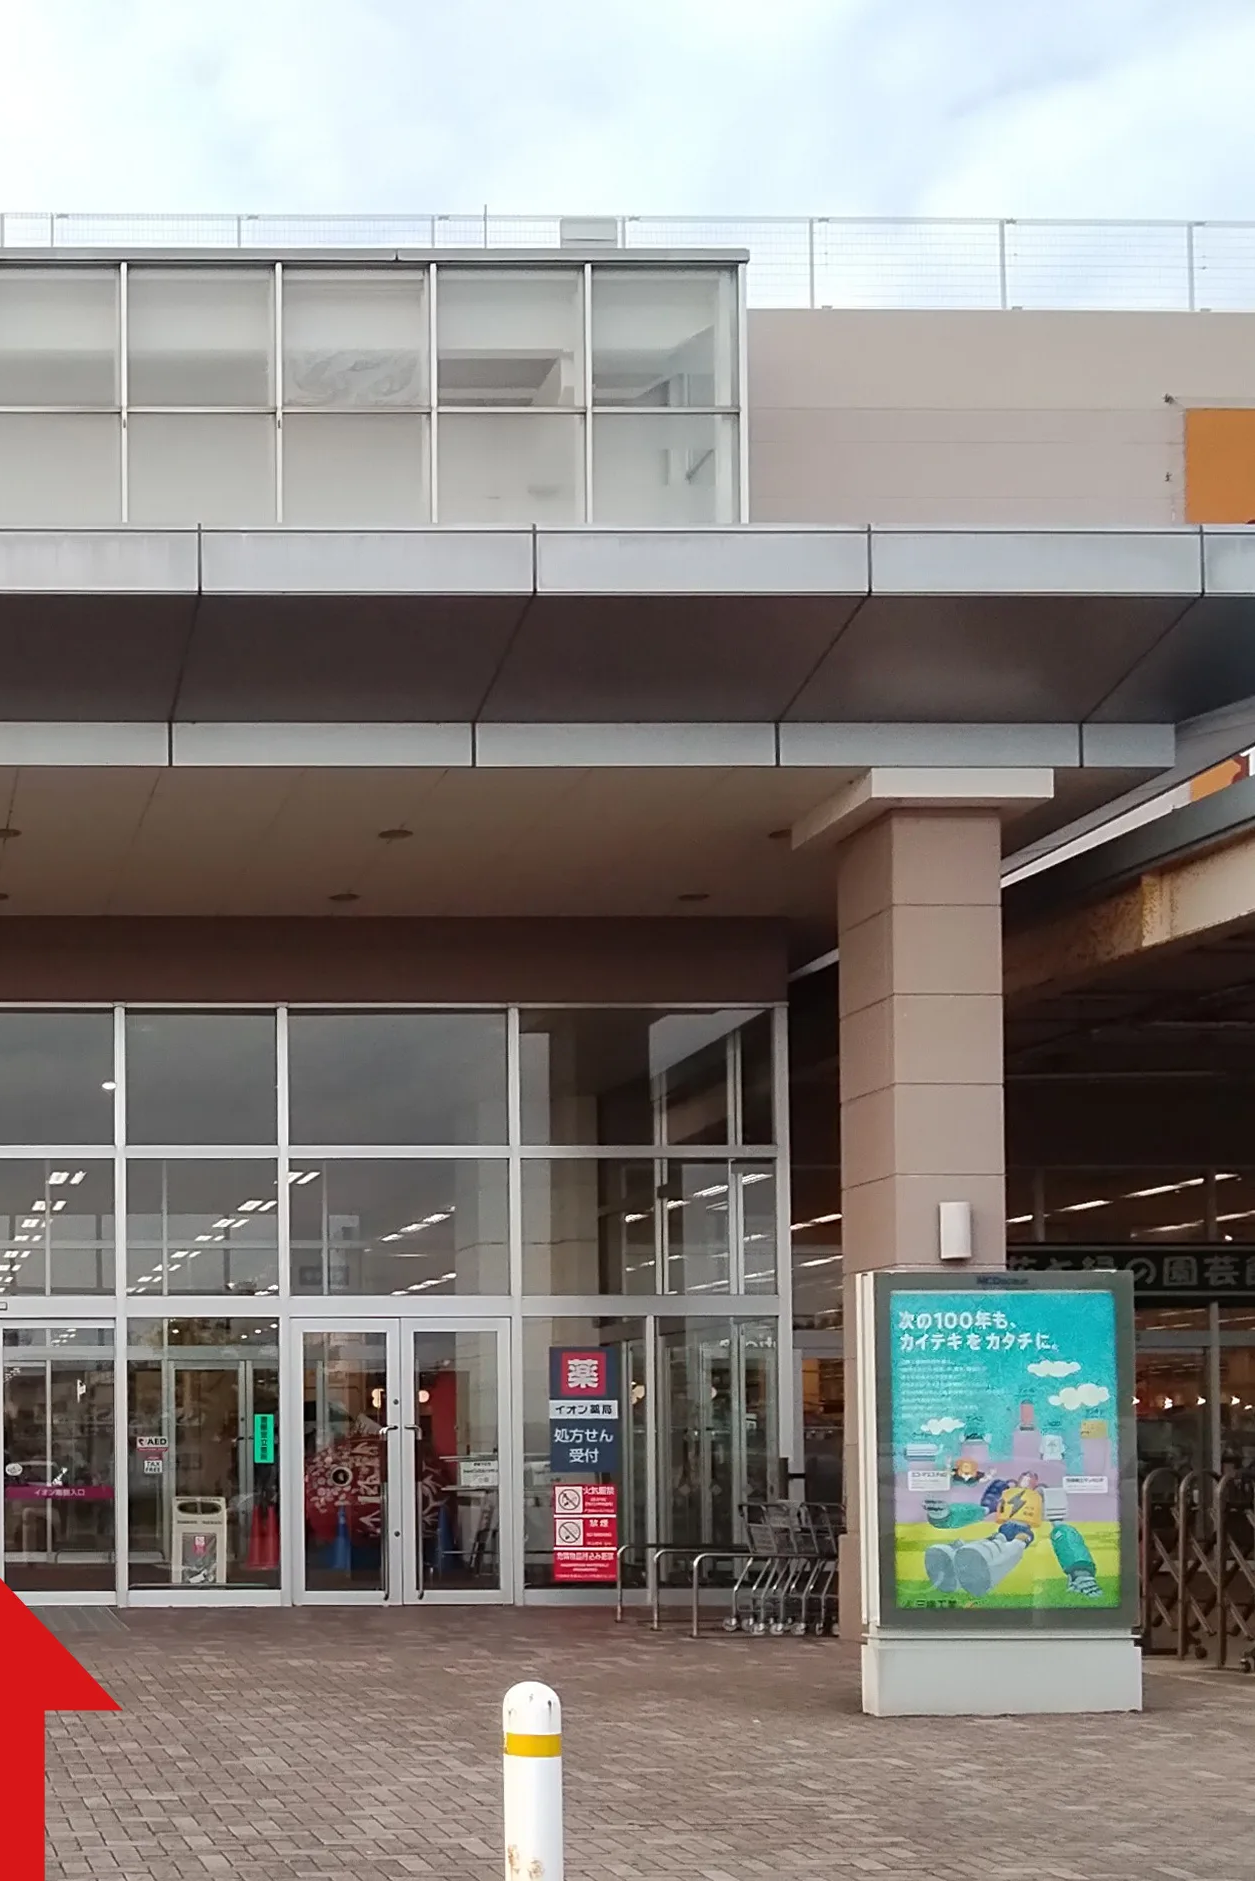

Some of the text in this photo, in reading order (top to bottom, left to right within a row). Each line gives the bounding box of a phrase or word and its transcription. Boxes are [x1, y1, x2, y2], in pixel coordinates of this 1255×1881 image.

[898, 1310, 1017, 1330] 次の100年も、
[567, 1358, 599, 1389] 薬
[555, 1404, 613, 1415] イオン薬局
[554, 1428, 614, 1443] 処方せん
[568, 1448, 599, 1463] 受付
